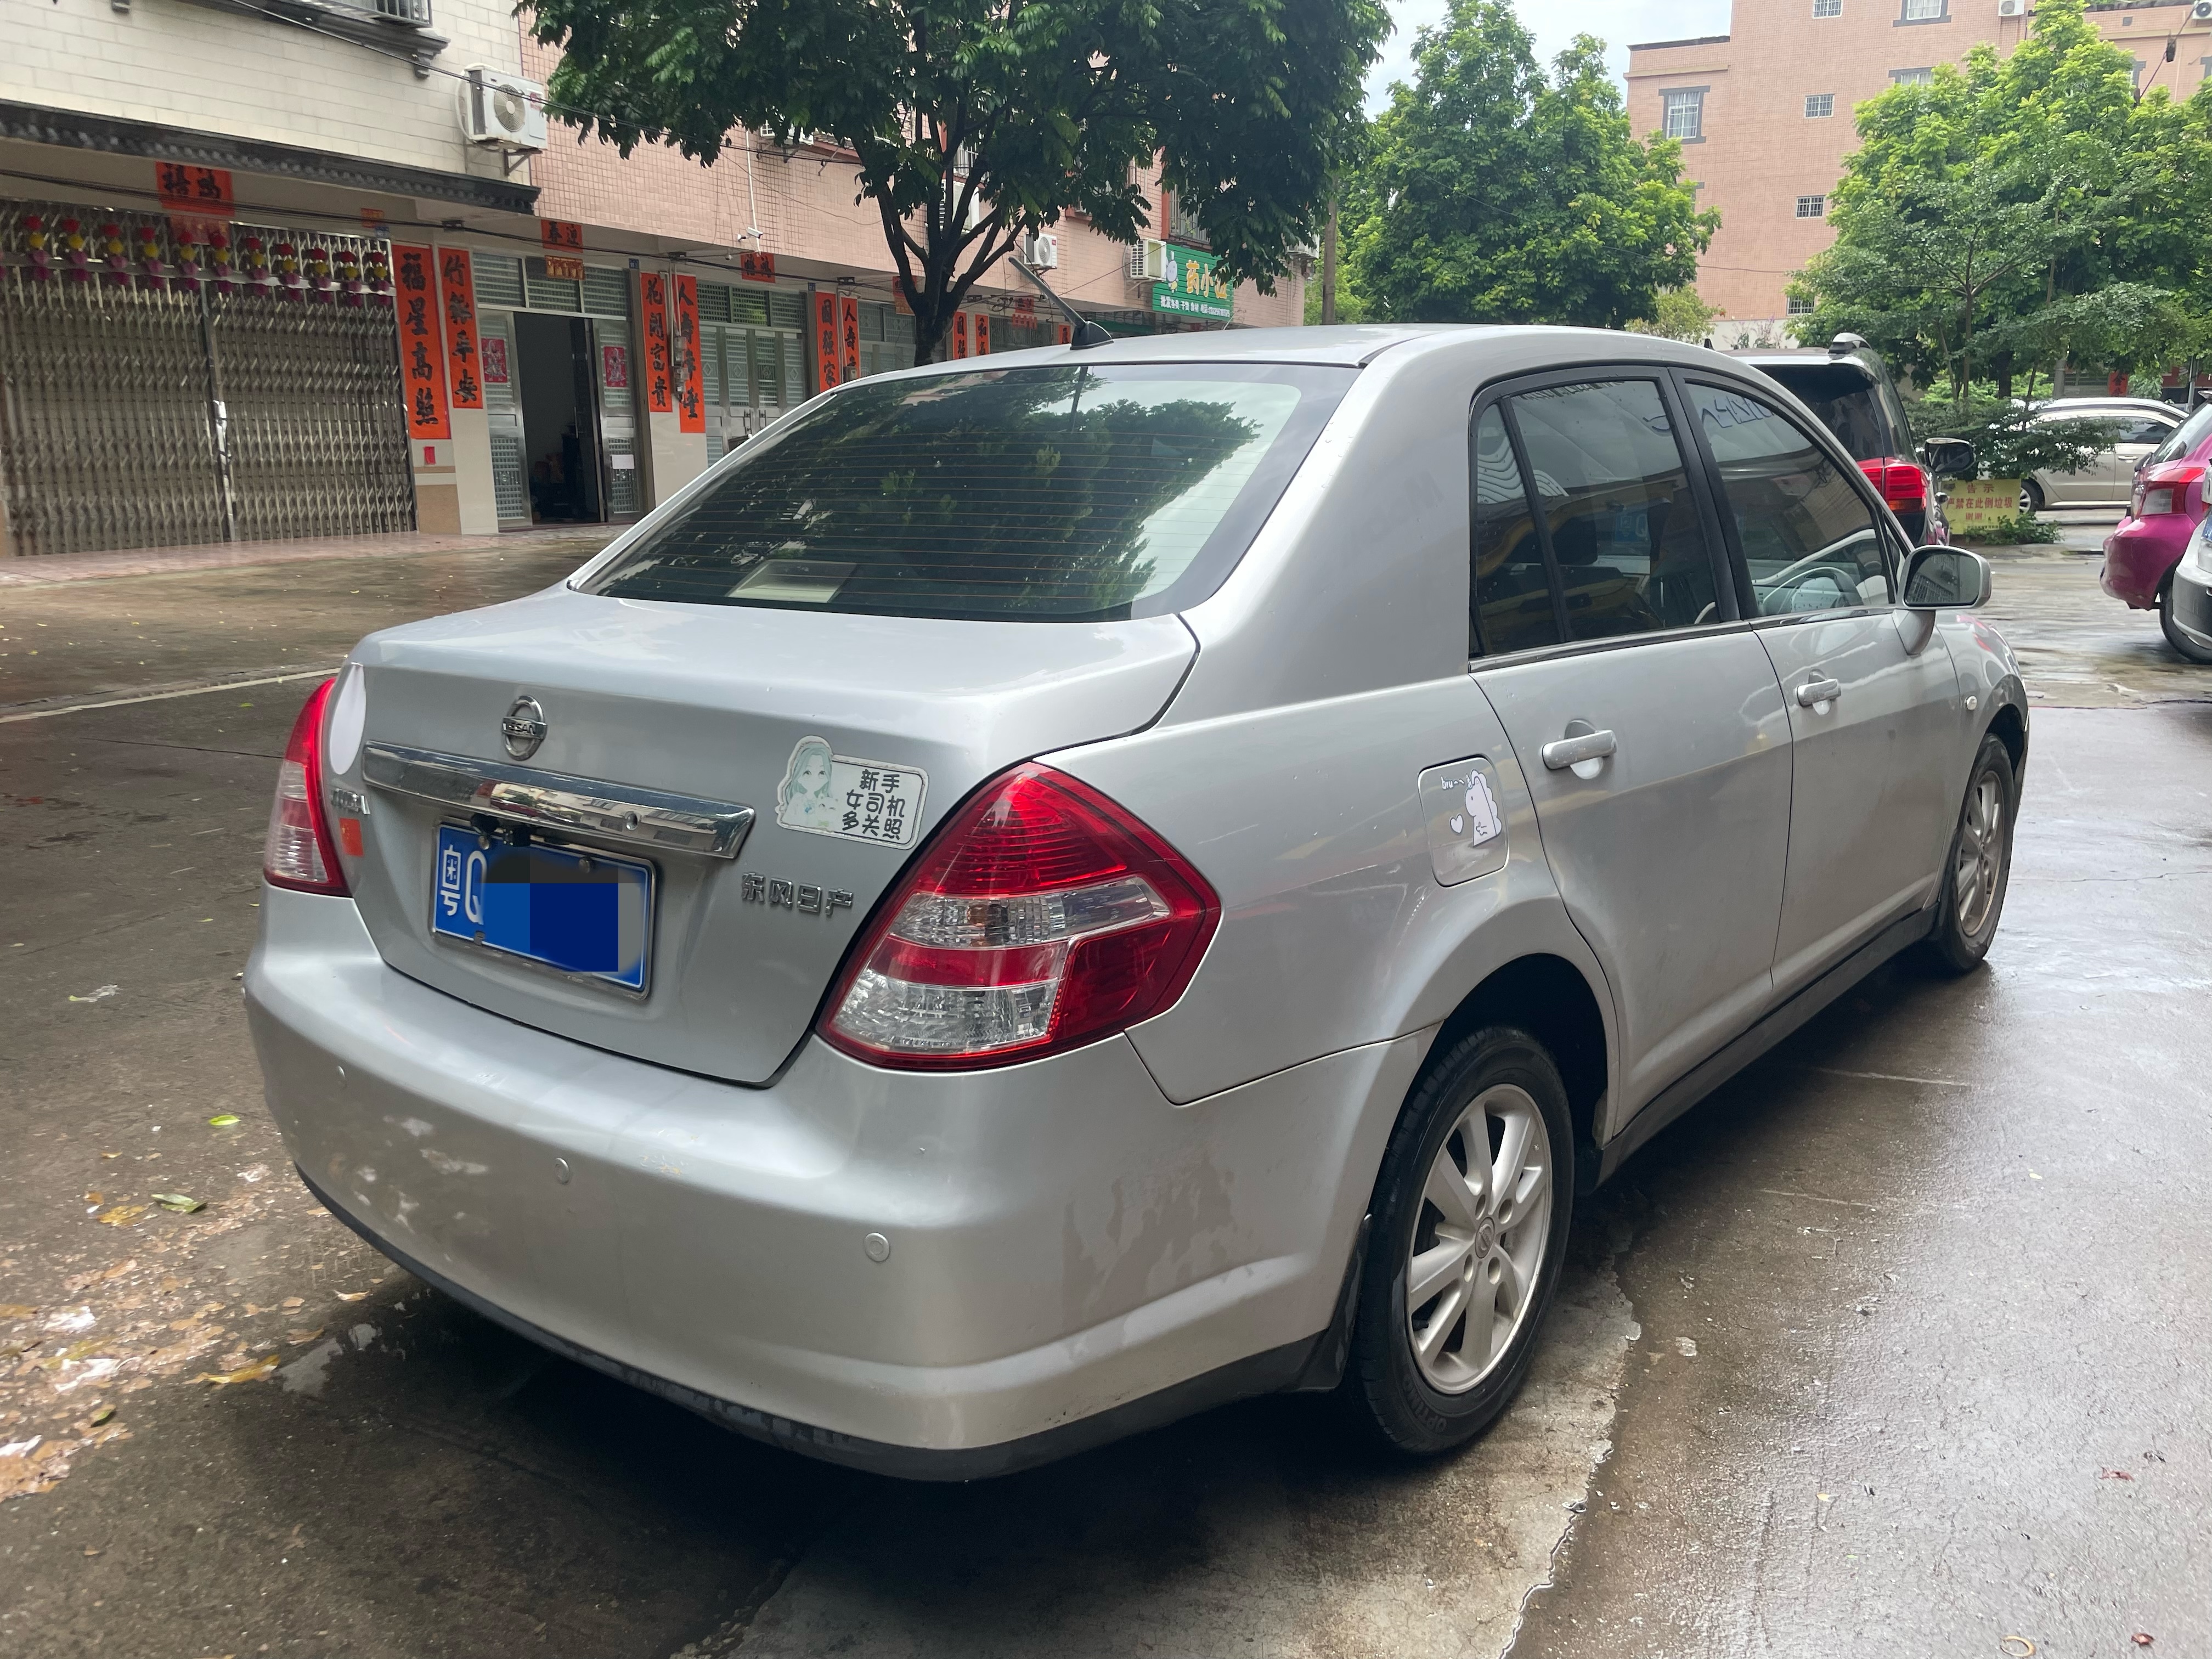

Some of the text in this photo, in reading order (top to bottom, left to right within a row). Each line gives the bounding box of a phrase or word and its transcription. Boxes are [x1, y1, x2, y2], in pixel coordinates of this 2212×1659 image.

[1966, 482, 1995, 493] 告示
[1946, 496, 2013, 509] 严禁在此倒垃圾
[503, 721, 536, 736] SSAN
[859, 769, 900, 793] 新手
[846, 789, 905, 819] 女司机
[842, 810, 902, 840] 多关照
[742, 872, 854, 918] 东风日产
